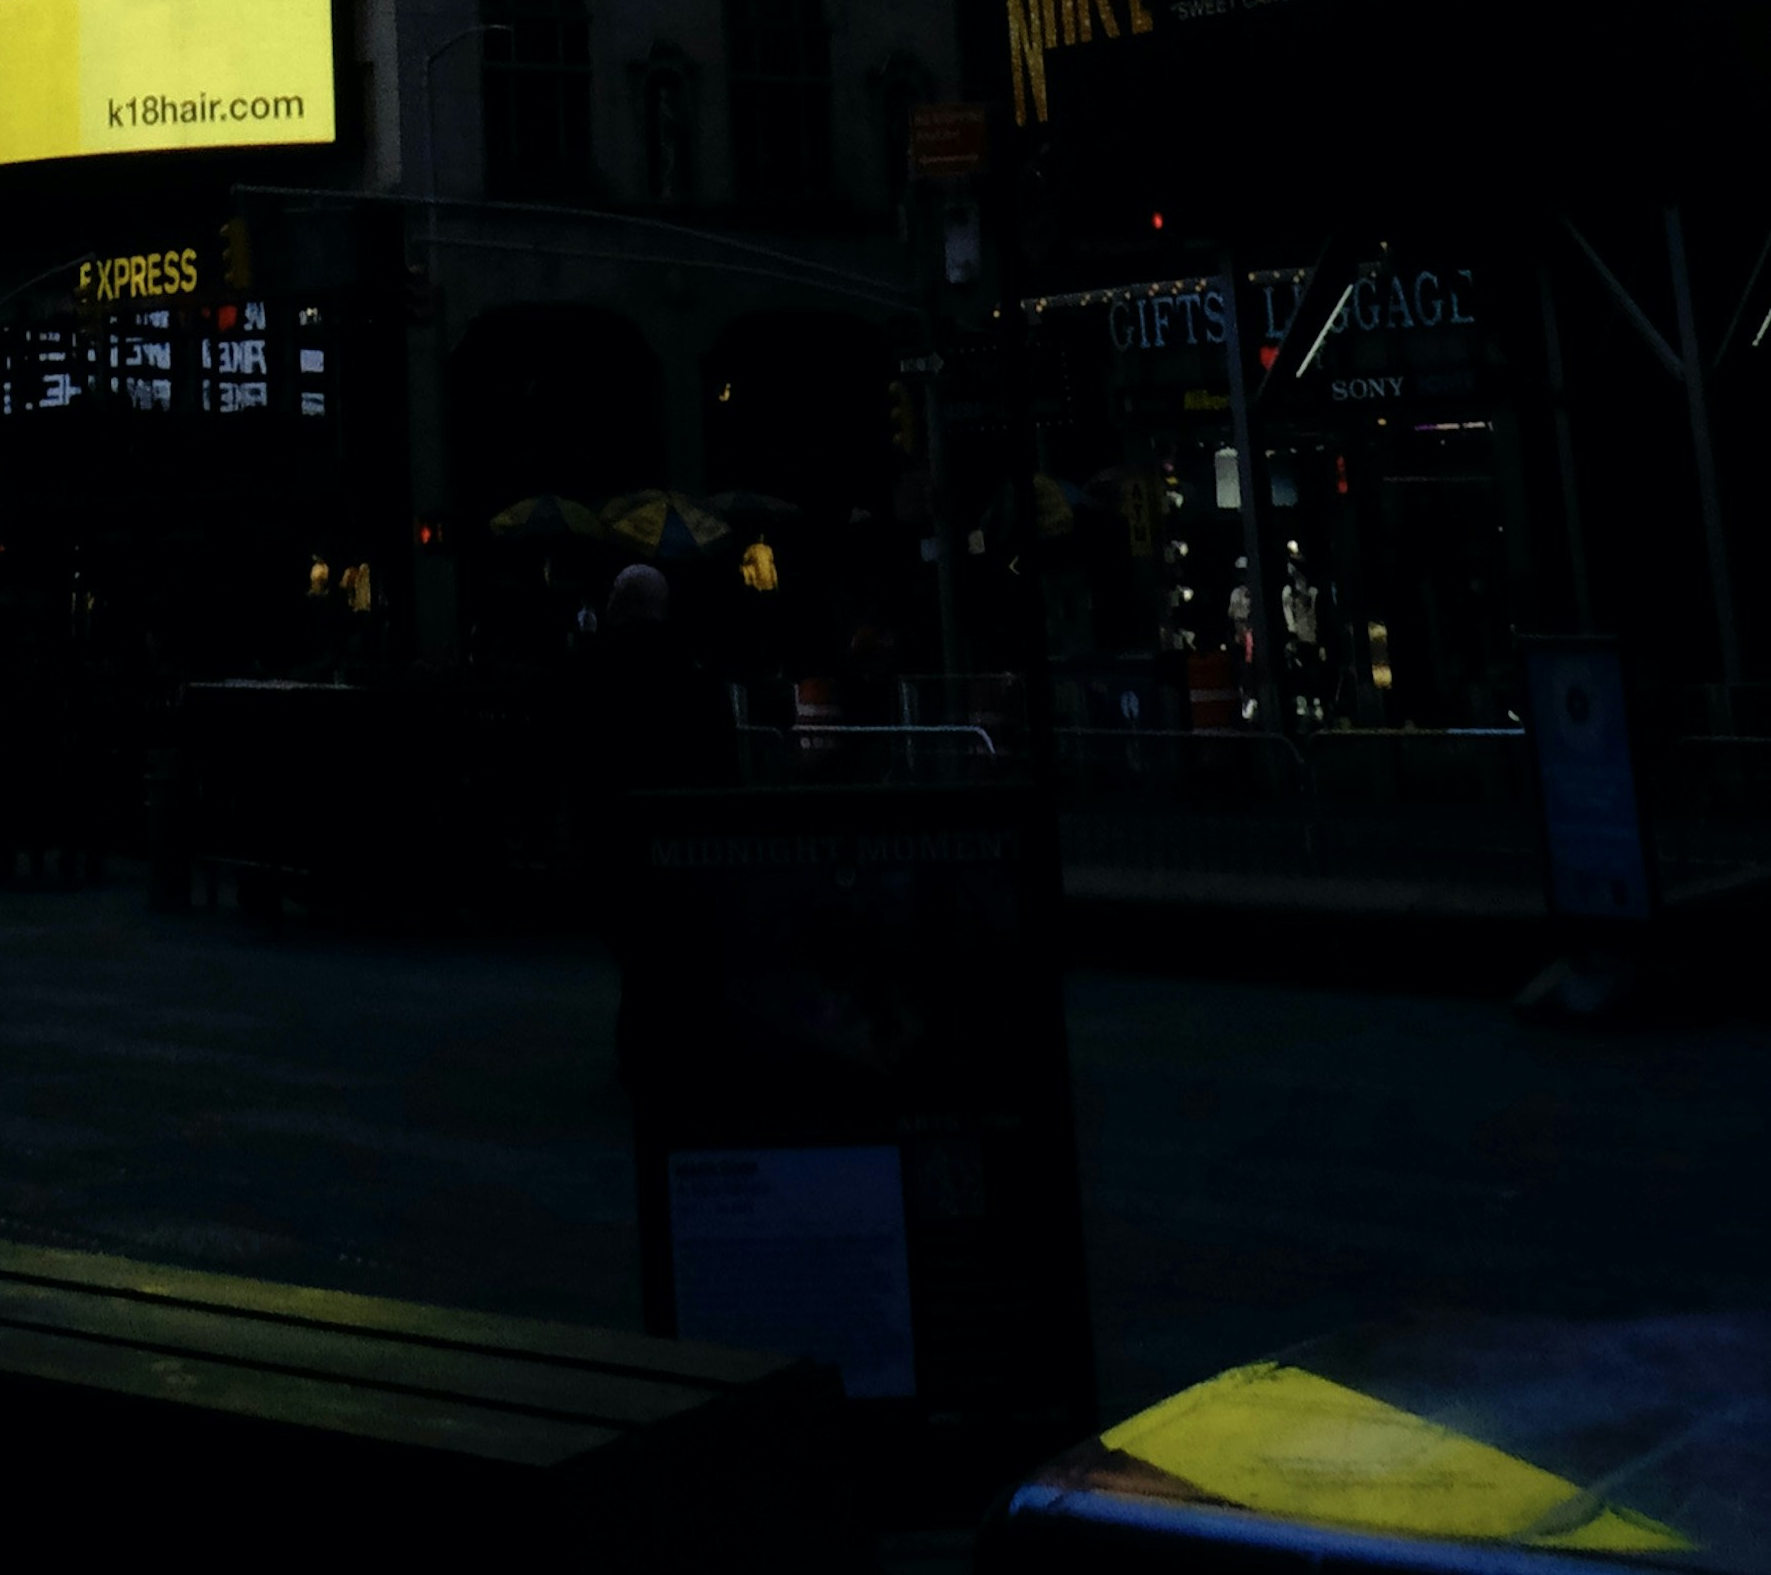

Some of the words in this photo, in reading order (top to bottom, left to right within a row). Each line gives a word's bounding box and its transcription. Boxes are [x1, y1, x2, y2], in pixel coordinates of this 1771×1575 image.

[107, 91, 305, 129] k18hair.com
[79, 247, 198, 303] EXPRESS
[1108, 290, 1227, 353] GIFTS
[1330, 375, 1405, 402] SONY
